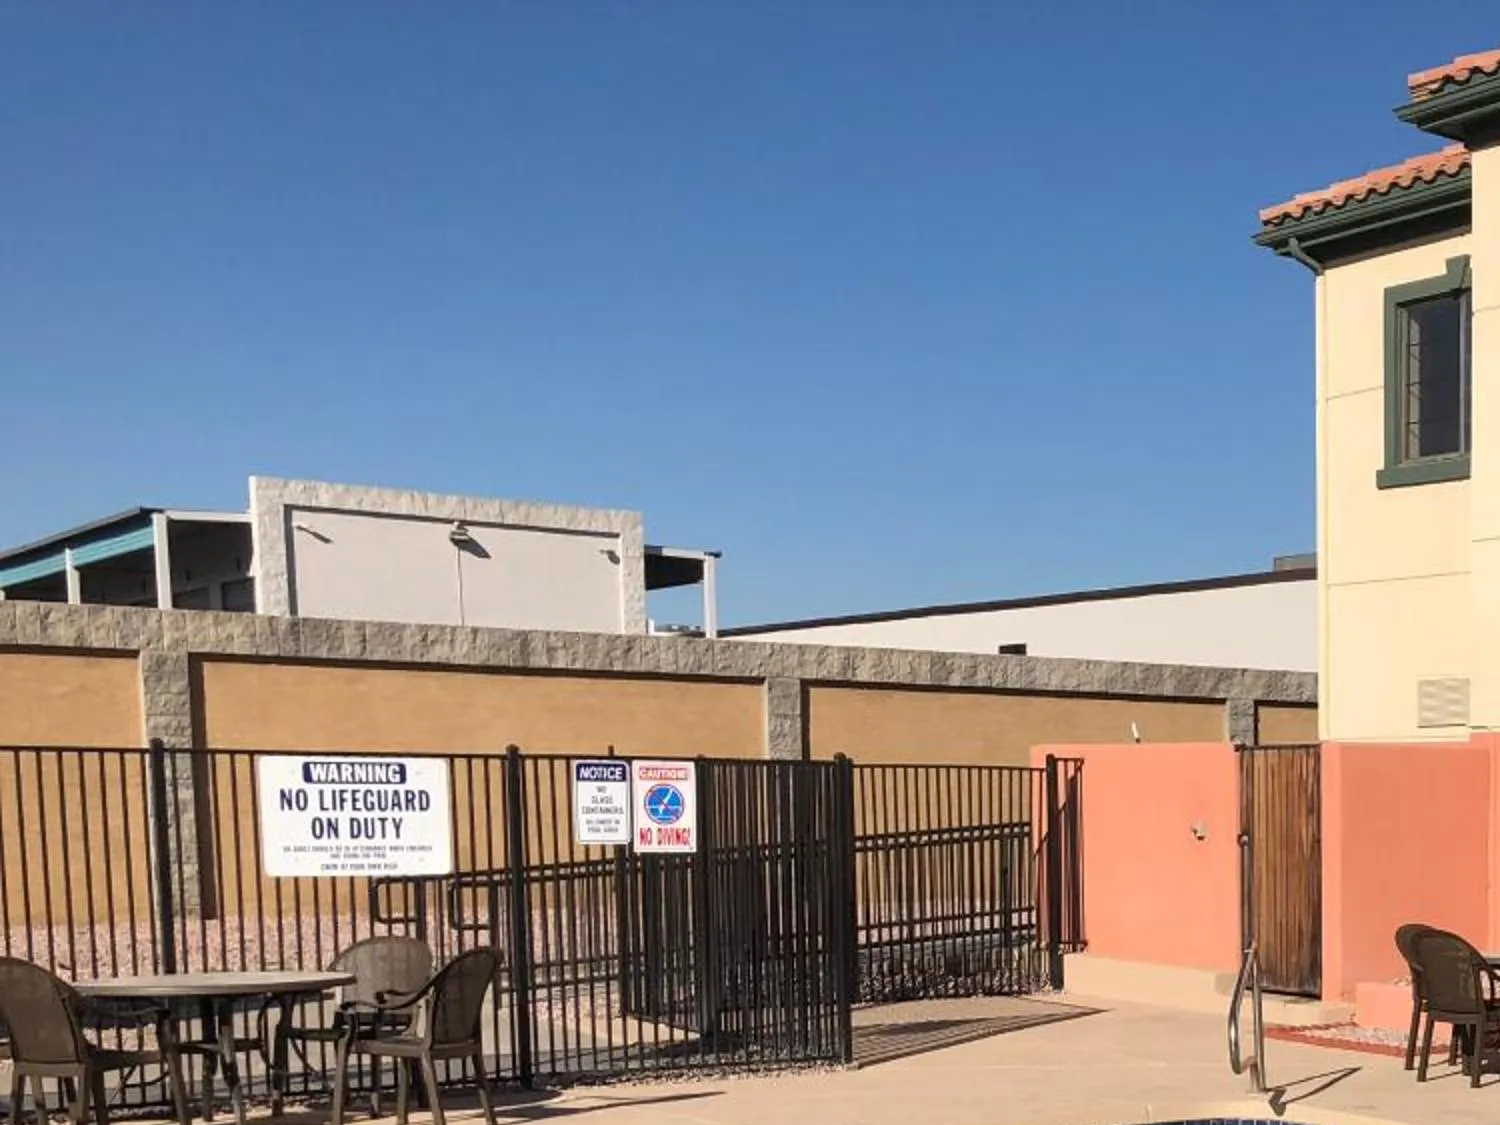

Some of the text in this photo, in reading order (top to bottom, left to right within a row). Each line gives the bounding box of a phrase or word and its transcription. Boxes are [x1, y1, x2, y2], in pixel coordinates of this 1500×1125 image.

[310, 762, 401, 783] WARNING
[579, 766, 624, 780] NOTICE
[279, 788, 431, 813] NO LIFEGUARD
[311, 816, 404, 841] ON DUTY
[639, 826, 653, 845] NO
